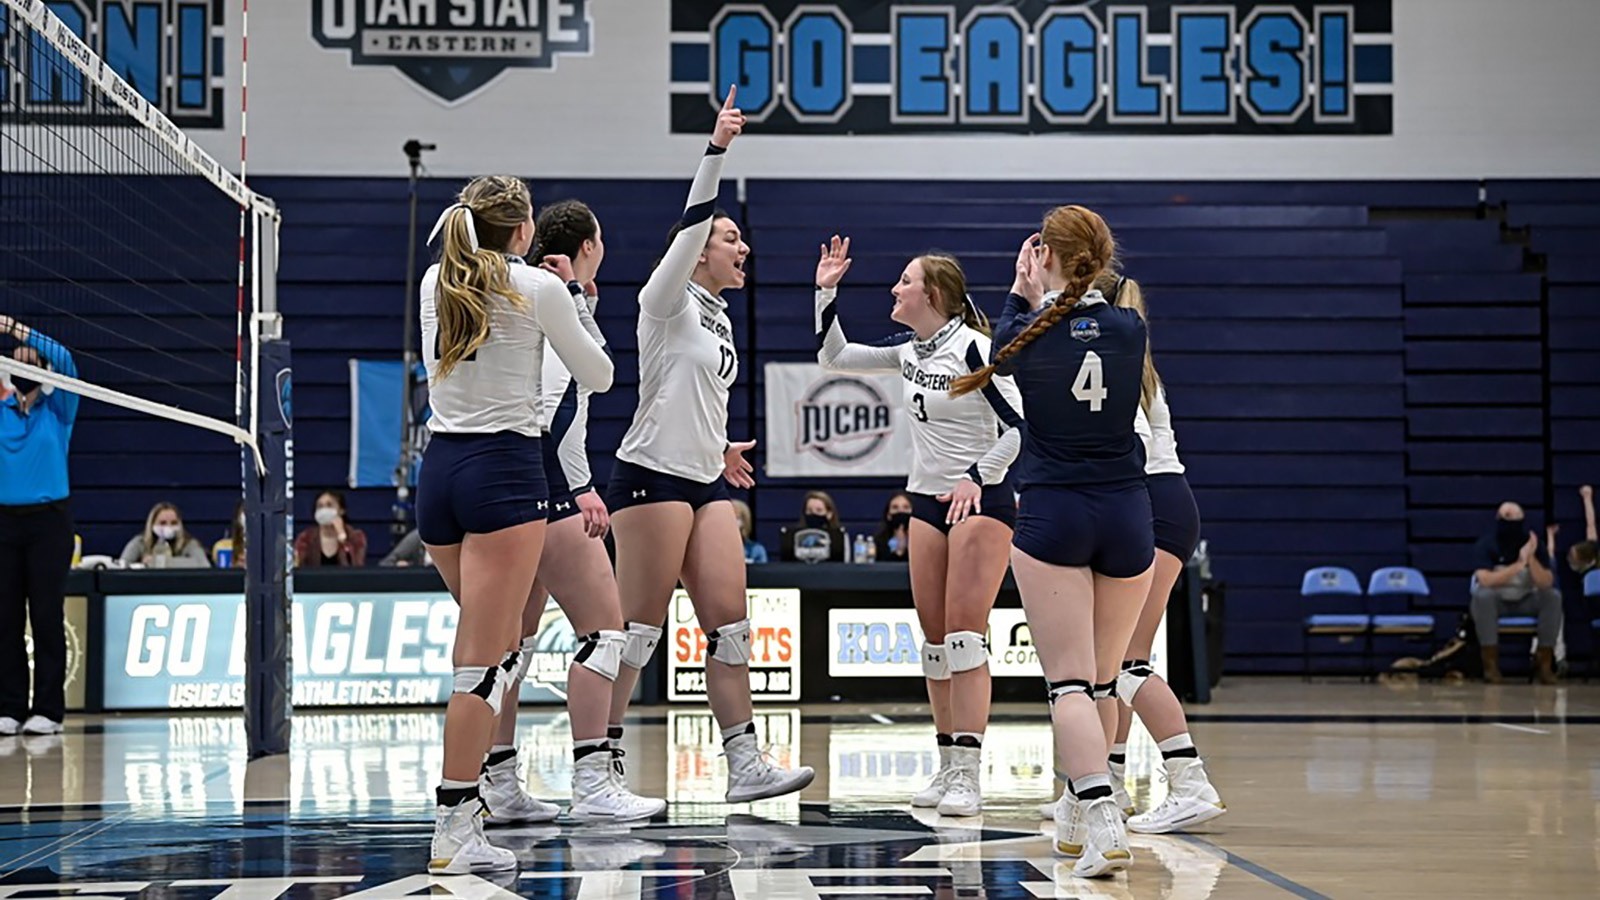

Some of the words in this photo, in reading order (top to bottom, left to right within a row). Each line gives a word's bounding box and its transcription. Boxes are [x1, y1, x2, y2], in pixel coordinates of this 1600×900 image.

[387, 34, 516, 51] EASTERN
[709, 5, 853, 122] GO
[891, 6, 1355, 123] EAGLES!
[717, 344, 735, 380] 17
[1071, 351, 1107, 412] 4
[801, 404, 890, 445] NJCAA
[912, 392, 929, 422] 3
[125, 604, 212, 677] GO
[676, 627, 792, 662] SPTS
[837, 622, 921, 664] KOA
[168, 679, 442, 709] USUEASATHLETICS.COM
